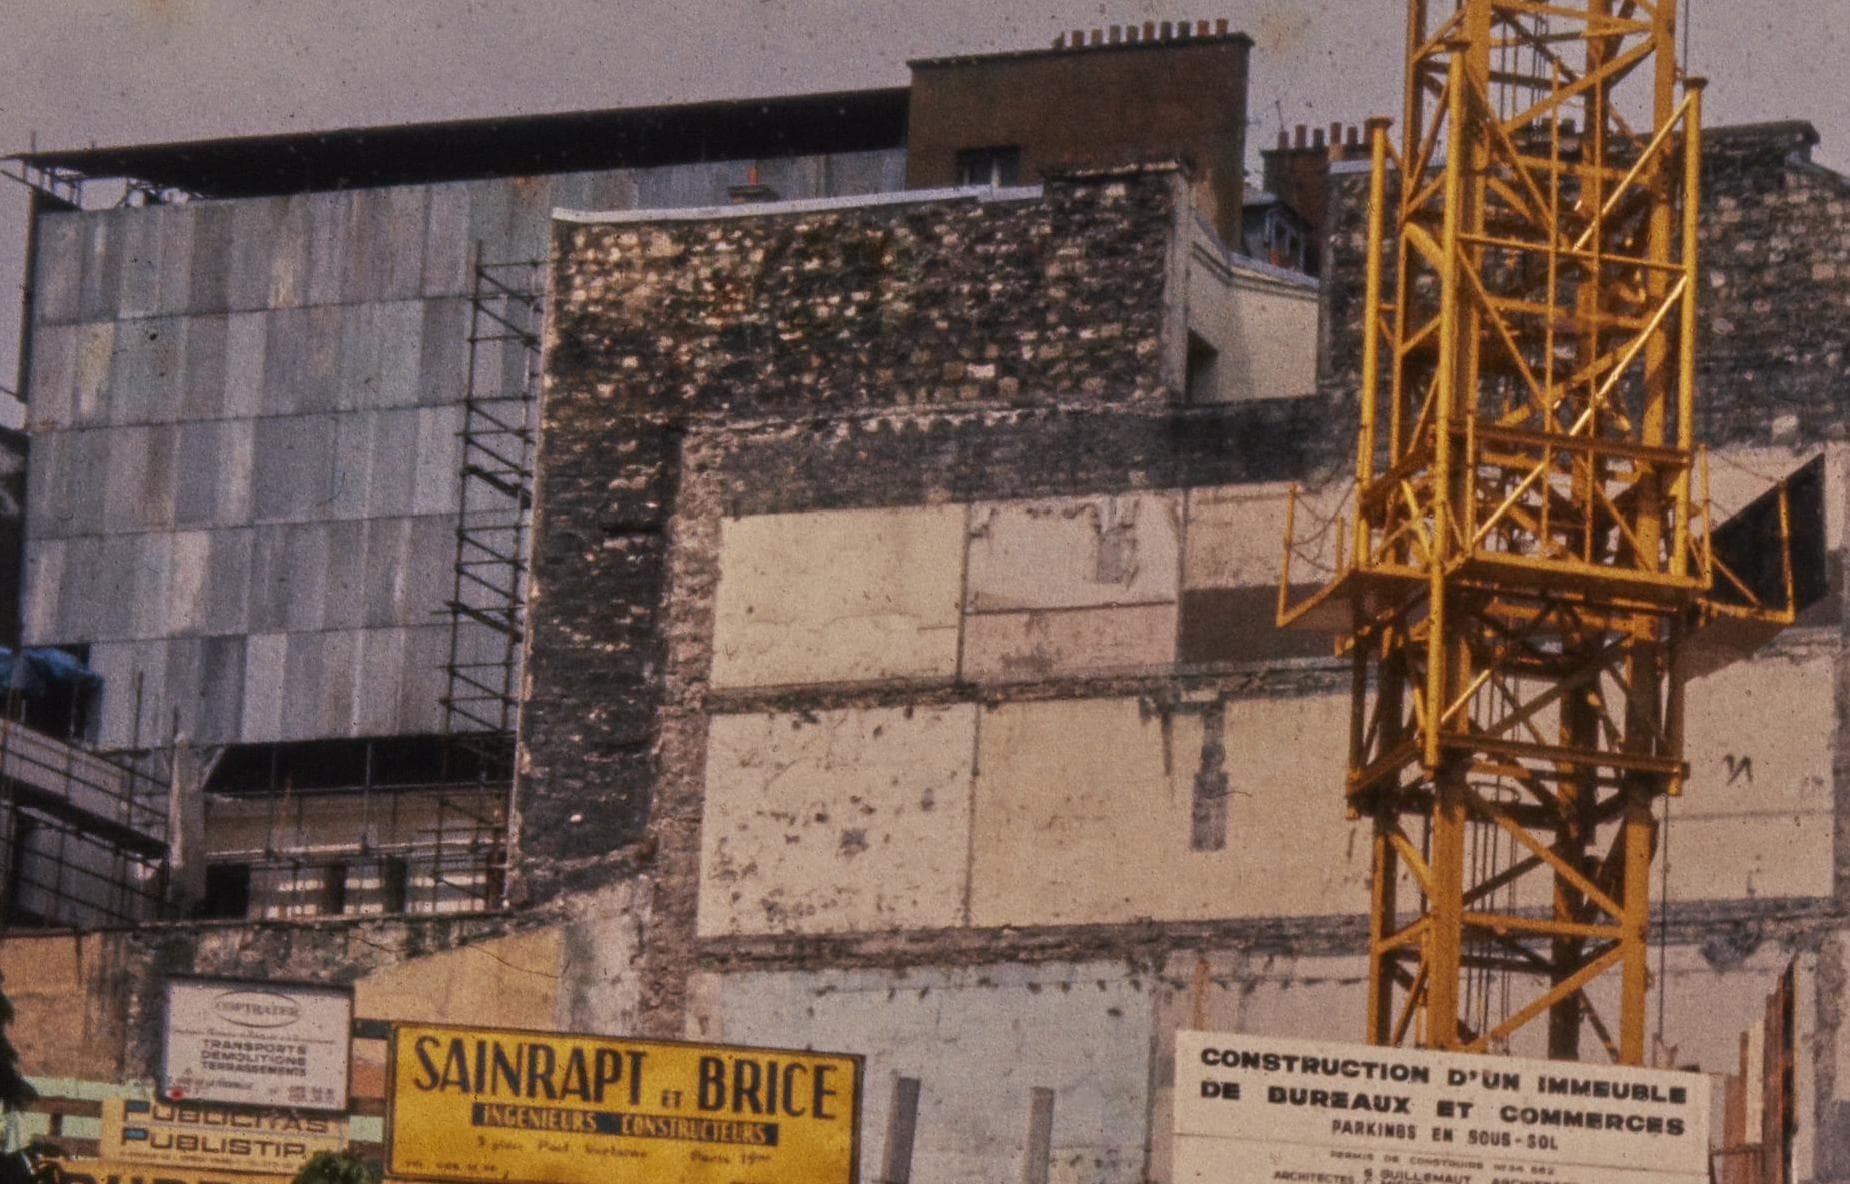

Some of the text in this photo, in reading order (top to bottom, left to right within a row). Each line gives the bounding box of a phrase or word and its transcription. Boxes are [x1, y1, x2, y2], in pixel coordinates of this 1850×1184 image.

[203, 1039, 308, 1056] TRANSPORTS
[413, 1035, 838, 1120] SAINRAPT ET BRICE
[1200, 1047, 1688, 1105] CONSTRUCTION D'UN IMMEUBLE
[620, 1112, 768, 1145] CONSTRUCTEURS
[1200, 1080, 1687, 1137] DE BUREAUX ET COMMERCES
[1332, 1119, 1417, 1142] PARKINGS
[1432, 1127, 1454, 1143] EN
